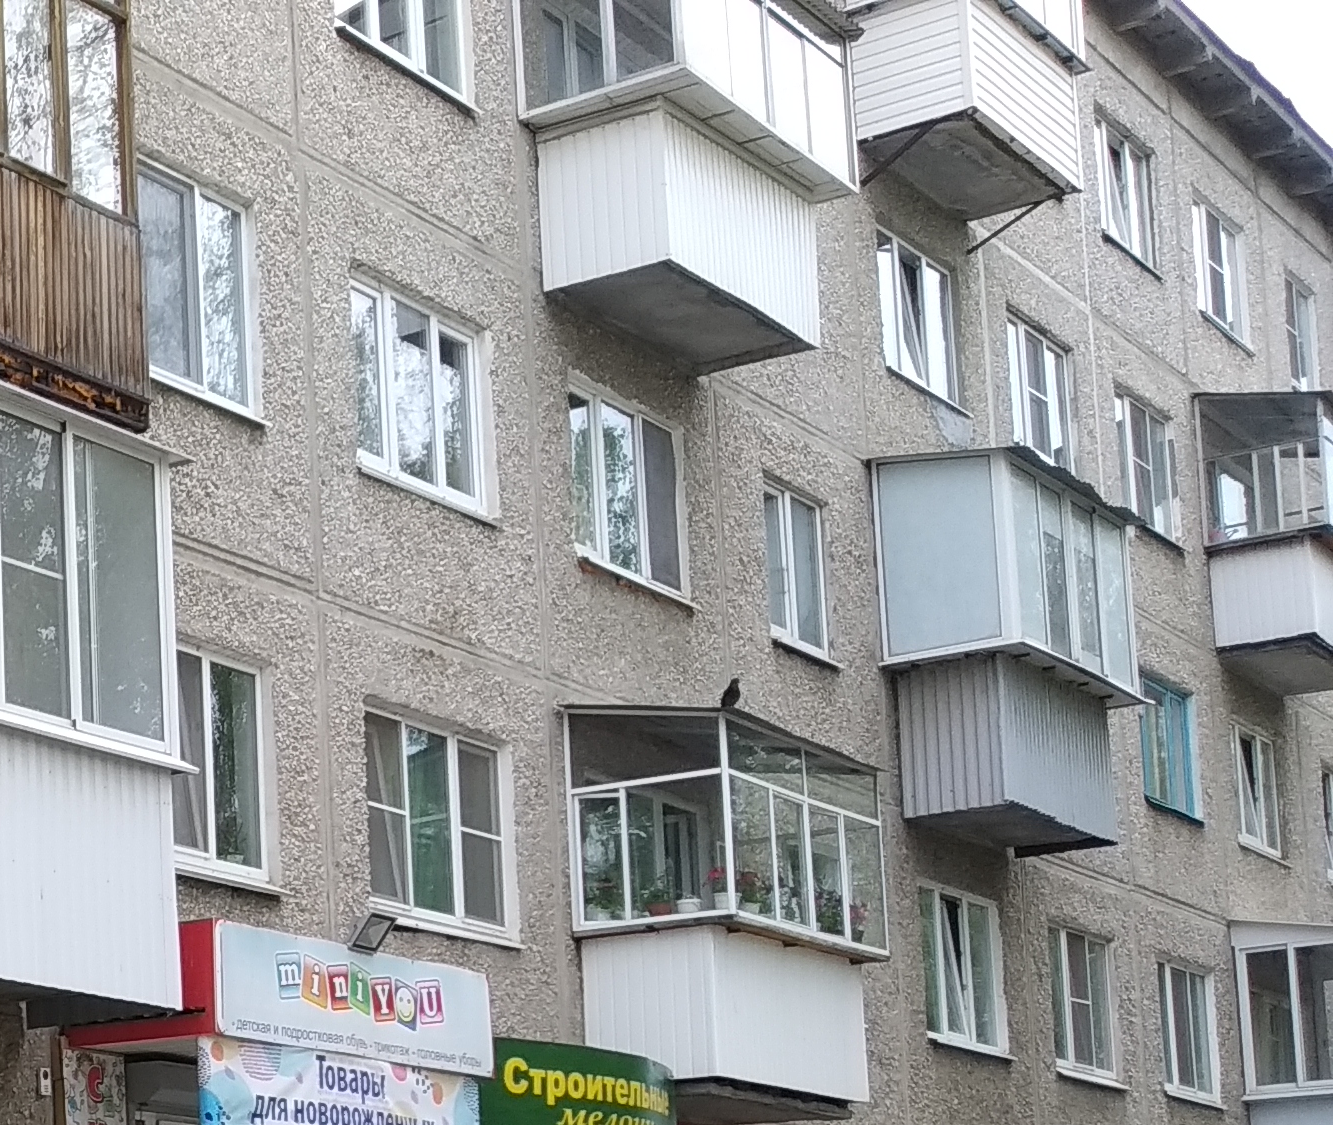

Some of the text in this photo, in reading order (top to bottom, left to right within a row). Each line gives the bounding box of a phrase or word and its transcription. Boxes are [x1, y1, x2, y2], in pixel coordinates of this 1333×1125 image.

[236, 1019, 272, 1034] детская
[281, 1026, 344, 1043] подростковая
[315, 1054, 386, 1105] Товары
[251, 1094, 289, 1125] для
